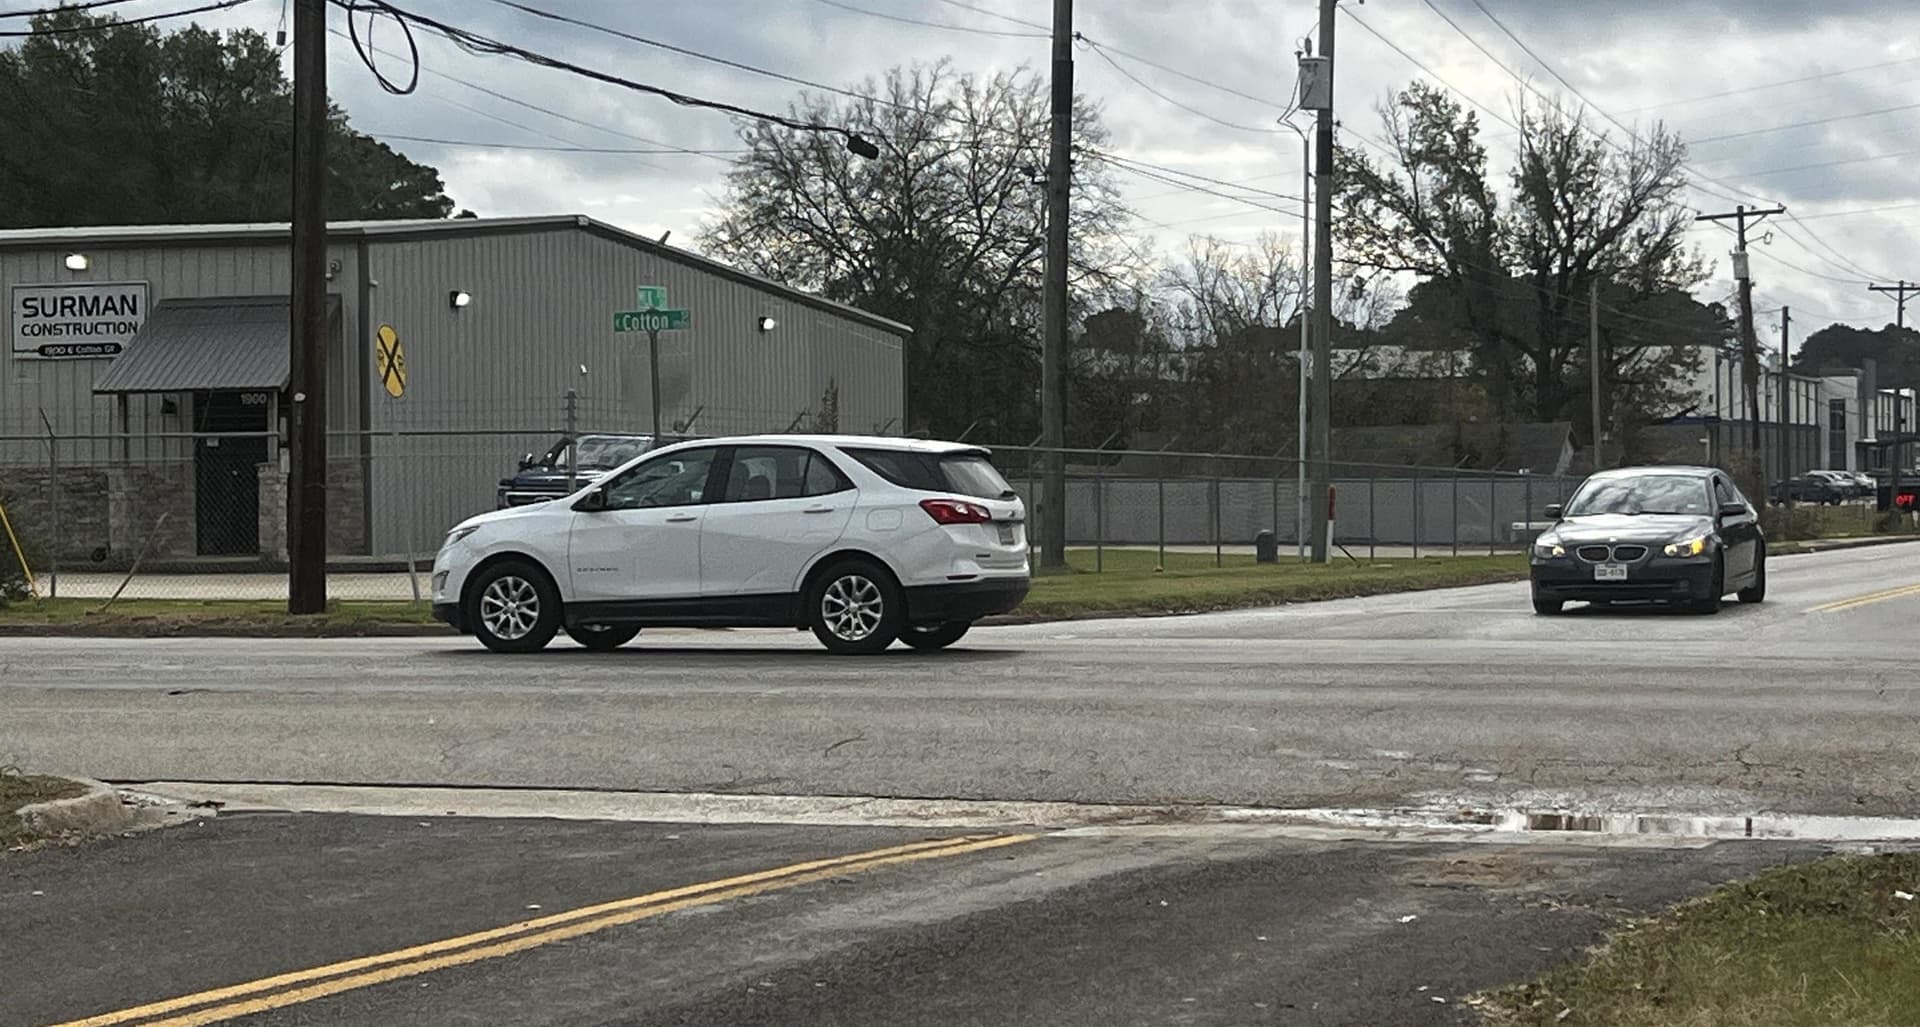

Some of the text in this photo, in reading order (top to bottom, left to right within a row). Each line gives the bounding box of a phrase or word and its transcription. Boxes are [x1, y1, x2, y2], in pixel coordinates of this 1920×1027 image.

[22, 294, 138, 318] SURMAN
[21, 321, 138, 336] CONSTRUCTION
[623, 313, 669, 331] Cotton
[241, 393, 267, 404] 1900
